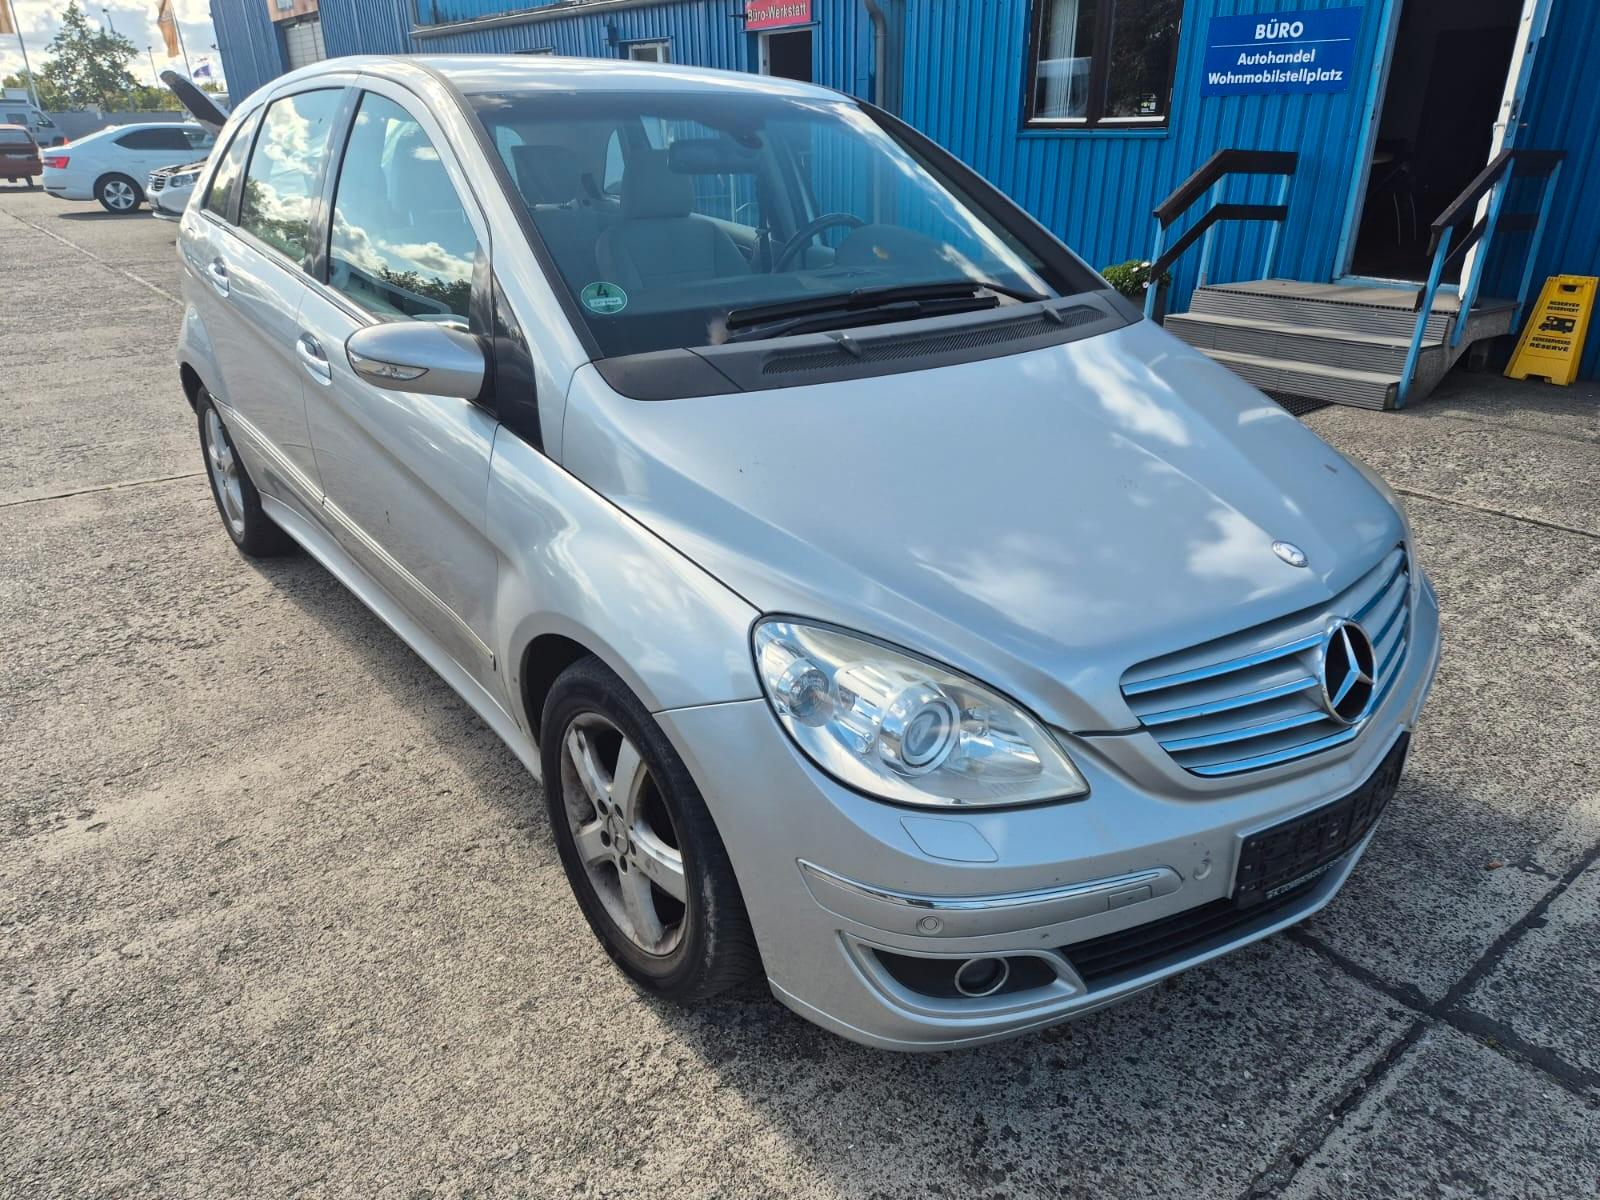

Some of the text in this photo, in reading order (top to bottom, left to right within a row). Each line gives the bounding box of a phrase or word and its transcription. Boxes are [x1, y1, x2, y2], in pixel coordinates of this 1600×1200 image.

[747, 3, 806, 22] Büro-Werkstatt
[1255, 19, 1304, 39] BÜRO
[1237, 49, 1316, 66] Autohandel
[1208, 67, 1343, 85] Wohnmobilstellplatz
[597, 285, 608, 297] 4
